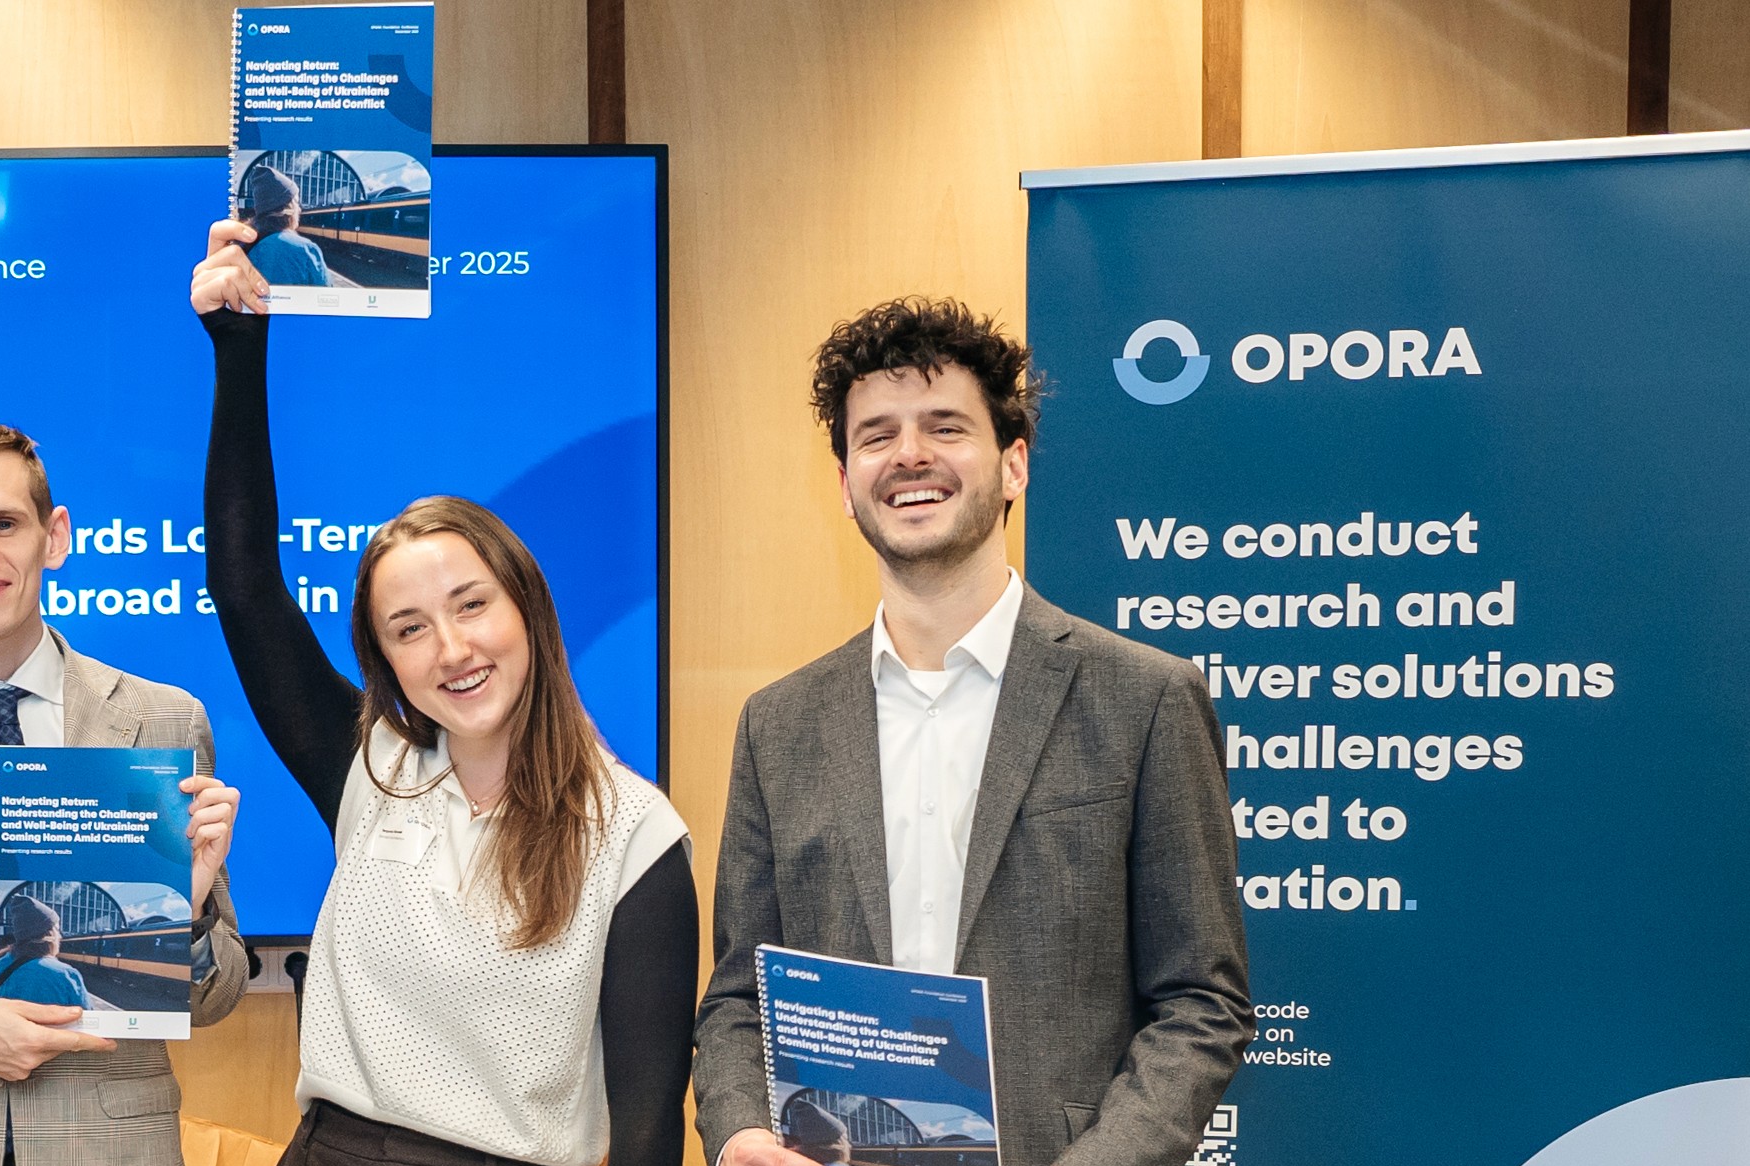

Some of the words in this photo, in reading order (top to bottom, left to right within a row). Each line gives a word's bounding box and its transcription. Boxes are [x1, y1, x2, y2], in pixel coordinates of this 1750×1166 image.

[261, 25, 290, 34] OPORA
[246, 61, 301, 72] Navigating
[303, 61, 339, 71] Return:
[246, 74, 320, 85] Understanding
[320, 74, 338, 83] the
[339, 74, 398, 85] Challenges
[245, 86, 265, 96] and
[266, 86, 320, 98] Well-Being
[322, 86, 333, 96] of
[334, 86, 390, 96] Ukrainians
[245, 99, 283, 110] Coming
[284, 99, 313, 108] Home
[314, 99, 341, 108] Amid
[343, 99, 385, 109] Conflict
[459, 251, 530, 275] 2025
[1231, 327, 1483, 384] OPORA
[1116, 517, 1209, 560] We
[1222, 511, 1479, 560] conduct
[40, 579, 181, 616] broad
[298, 576, 338, 613] in
[1117, 583, 1380, 630] research
[1396, 580, 1516, 628] and
[1192, 653, 1320, 699] iver
[1332, 651, 1614, 699] solutions
[1226, 725, 1523, 781] hallenges
[16, 763, 47, 771] OPORA
[2, 796, 59, 808] Navigating
[61, 798, 98, 806] Return:
[2, 808, 78, 820] Understanding
[79, 810, 97, 818] the
[99, 810, 158, 821] Challenges
[1342, 798, 1407, 840] to
[1, 820, 22, 829] and
[23, 821, 79, 832] Well-Being
[81, 821, 92, 830] of
[94, 822, 149, 831] Ukrainians
[1, 832, 41, 843] Coming
[43, 833, 73, 842] Home
[74, 833, 101, 842] Amid
[102, 834, 145, 843] Conflict
[786, 968, 820, 982] OPORA
[775, 1000, 836, 1020] Navigating
[838, 1011, 879, 1025] Return:
[1254, 1001, 1309, 1019] code
[776, 1012, 857, 1035] Understanding
[859, 1027, 878, 1036] the
[880, 1029, 947, 1045] Challenges
[1265, 1028, 1294, 1042] on
[776, 1025, 797, 1035] and
[799, 1028, 859, 1047] Well-Being
[861, 1039, 874, 1047] of
[875, 1040, 938, 1055] Ukrainians
[778, 1036, 819, 1052] Coming
[822, 1044, 854, 1057] Home
[856, 1050, 884, 1061] Amid
[887, 1054, 935, 1066] Conflict
[1243, 1047, 1331, 1066] website
